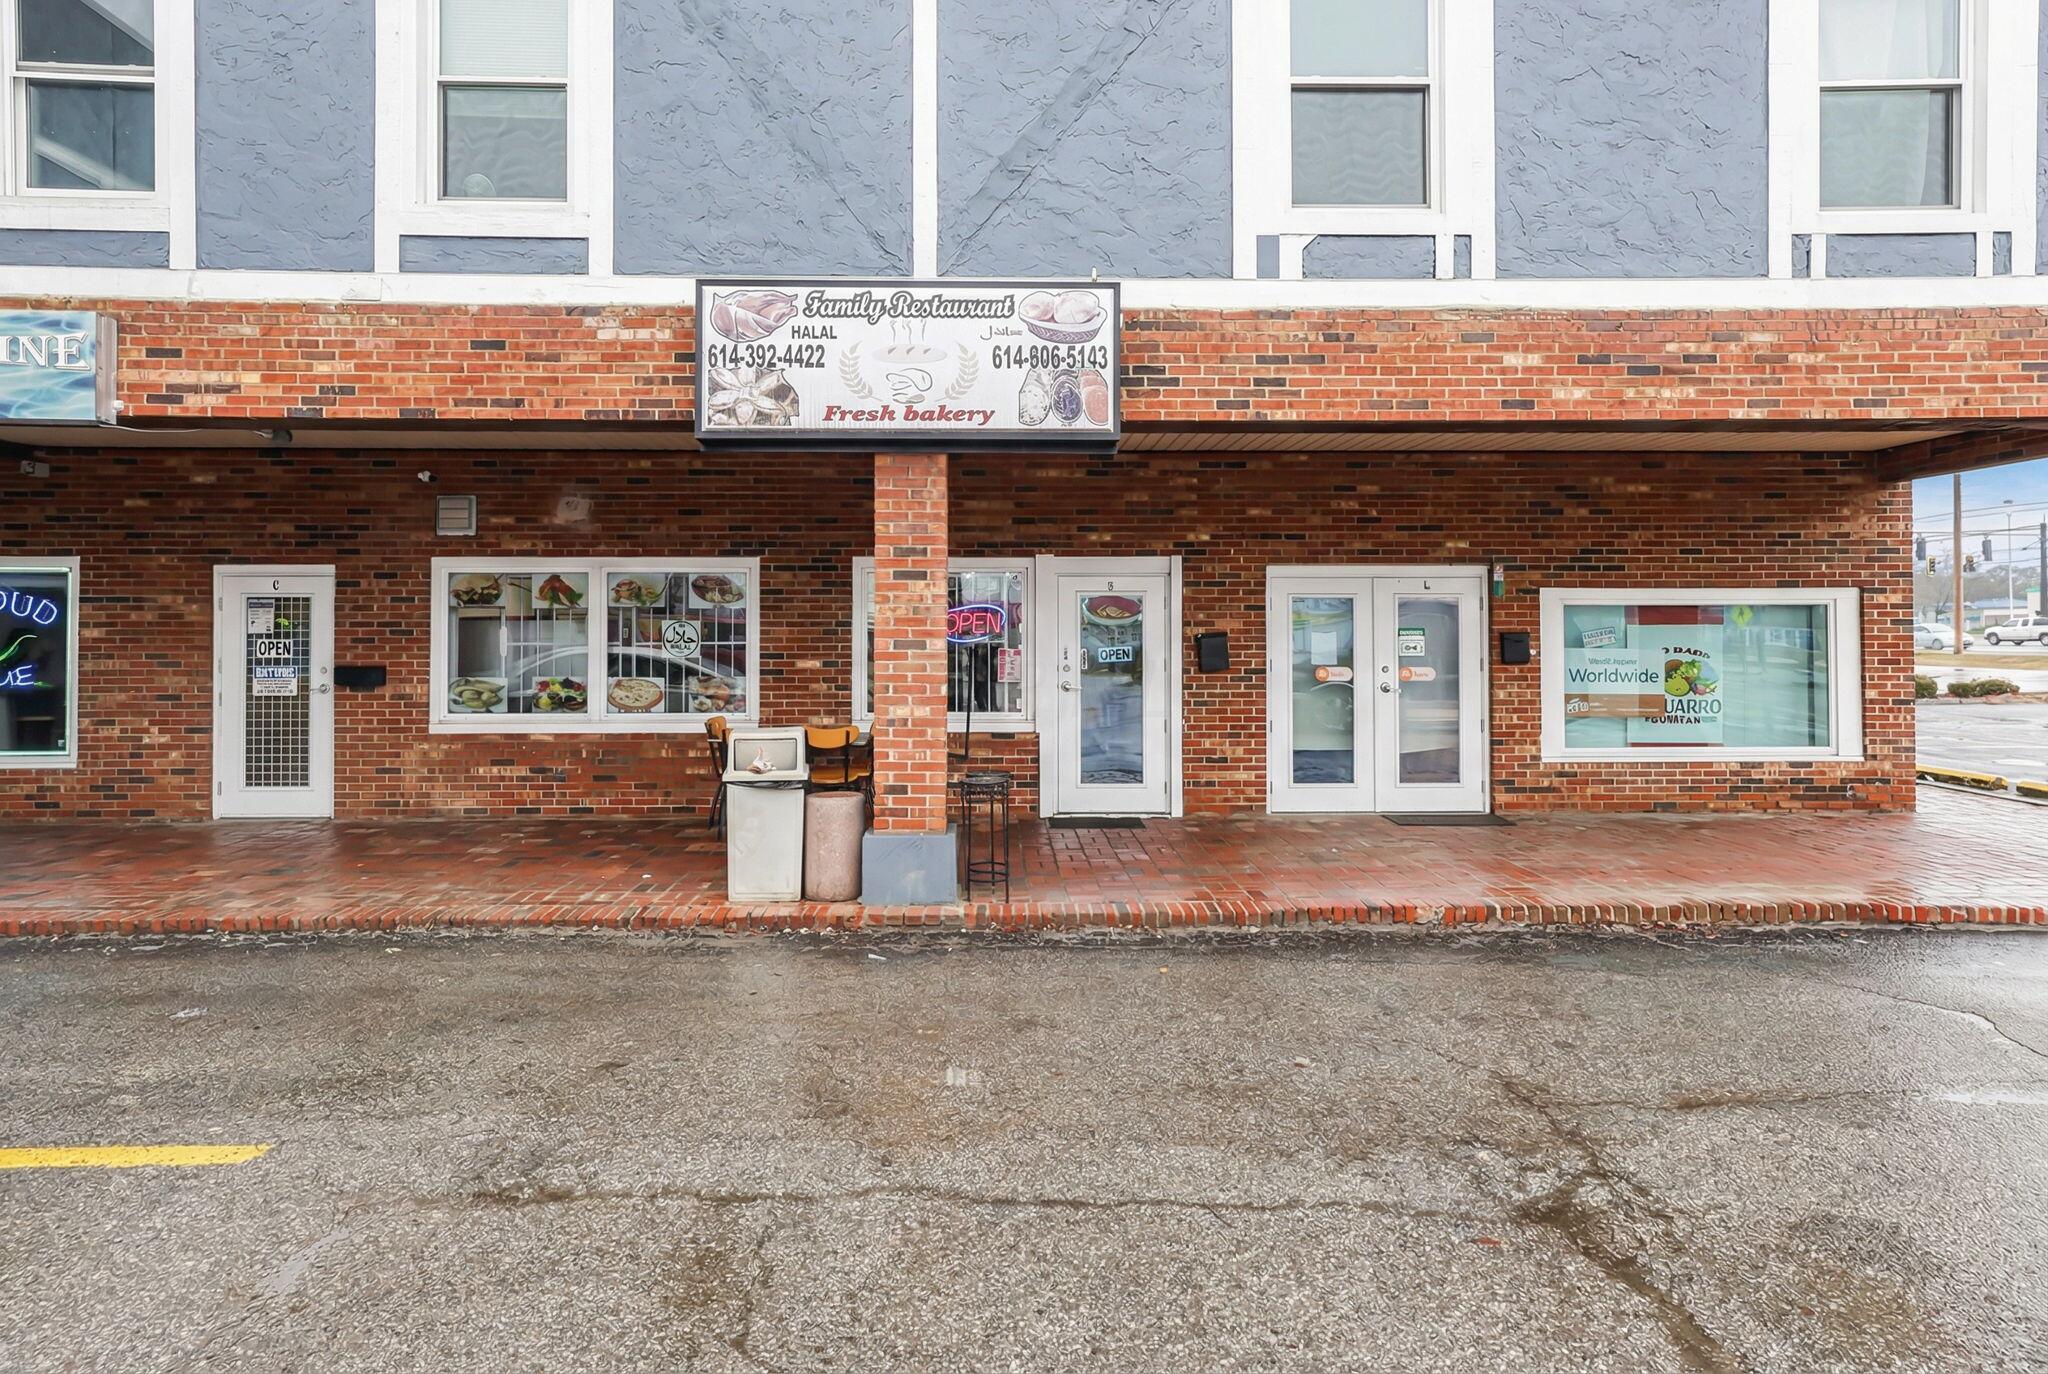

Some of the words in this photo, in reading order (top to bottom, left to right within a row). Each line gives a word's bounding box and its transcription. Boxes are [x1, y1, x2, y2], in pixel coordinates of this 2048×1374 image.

[803, 290, 888, 325] Family
[888, 290, 1015, 318] Restaurant
[791, 325, 838, 340] HALAL
[708, 344, 826, 368] 614-392-4422
[992, 345, 1108, 369] 614-806-5143
[821, 405, 896, 422] Fresh
[903, 405, 996, 426] bakery
[946, 612, 1001, 634] OPEN
[258, 641, 291, 656] OPEN
[1100, 648, 1131, 661] OPEN
[1568, 668, 1660, 683] Worldwide
